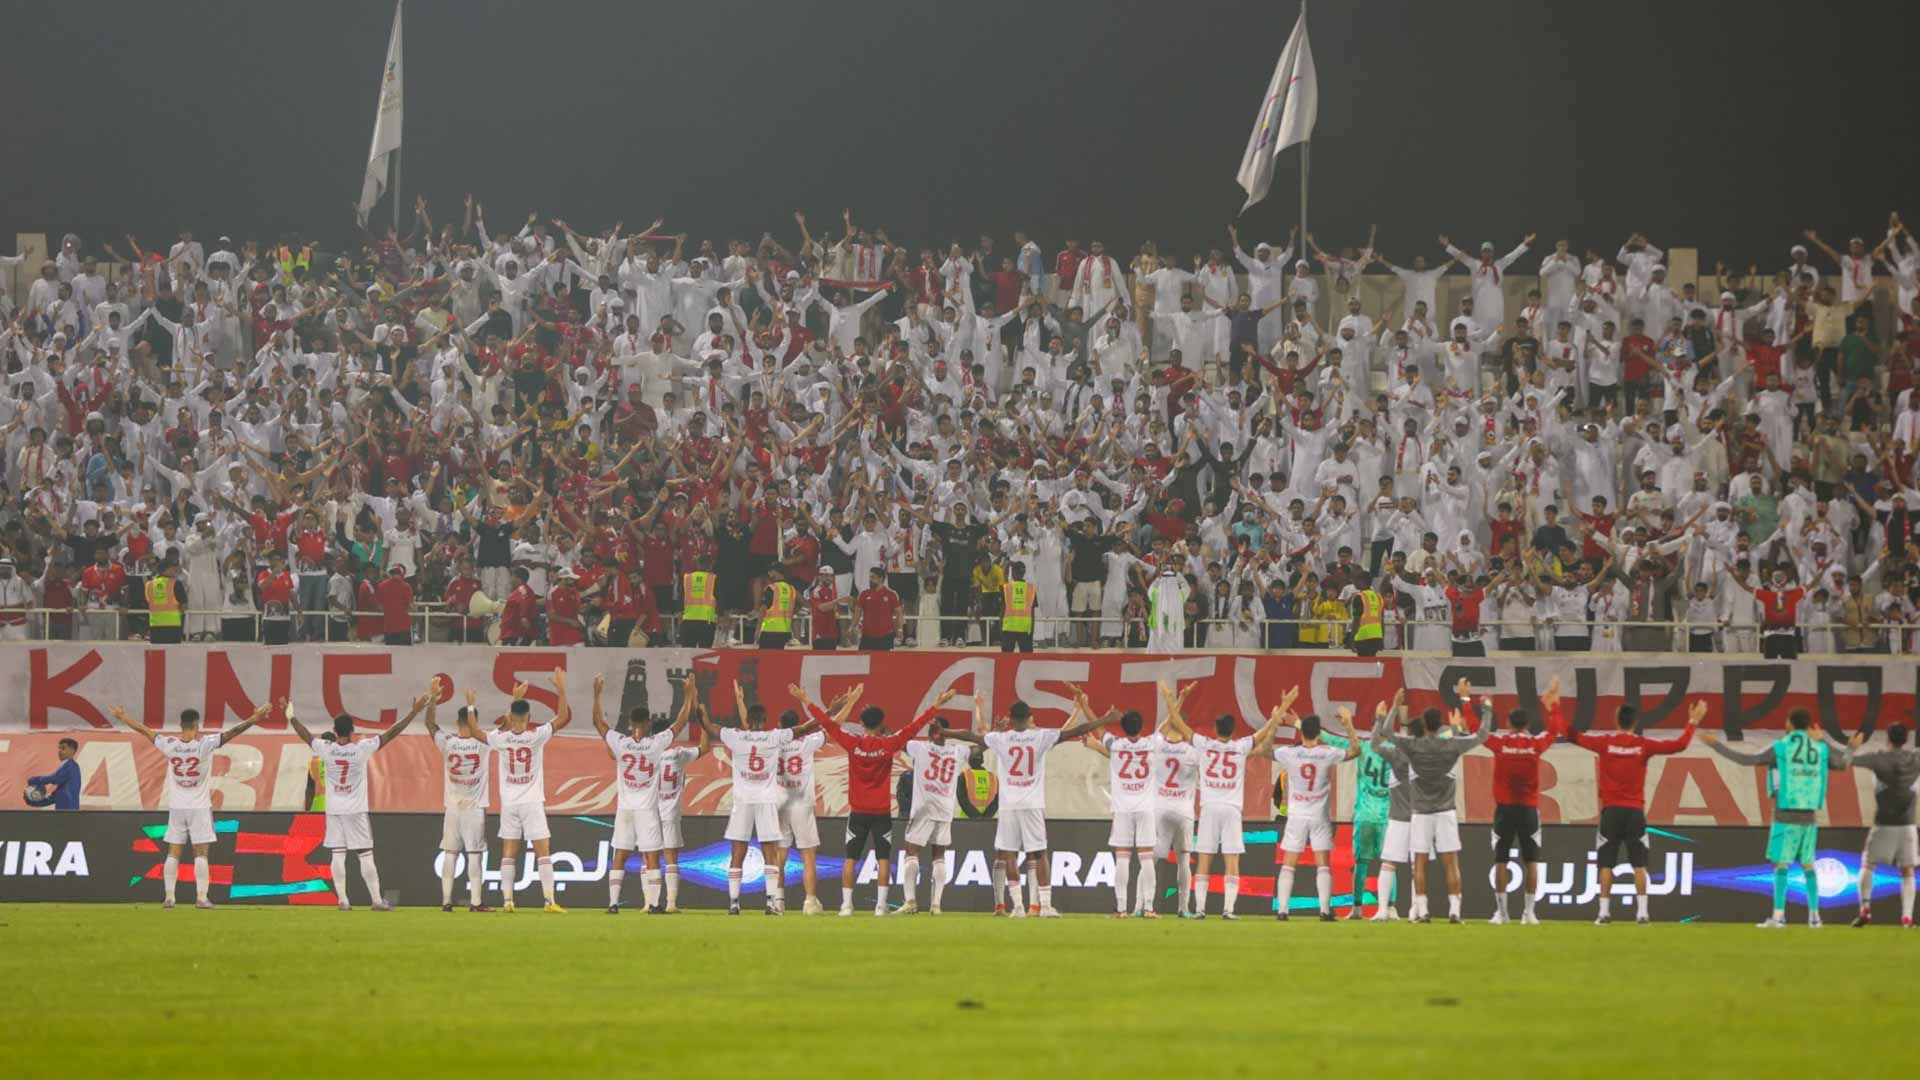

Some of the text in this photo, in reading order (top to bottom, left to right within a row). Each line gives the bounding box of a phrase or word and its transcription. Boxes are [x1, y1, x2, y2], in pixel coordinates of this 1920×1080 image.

[1438, 664, 1920, 745] SUPPO
[447, 753, 481, 776] 27
[506, 746, 533, 775] 19
[748, 744, 765, 773] 6
[1008, 745, 1035, 777] 21
[1118, 750, 1150, 780] 23
[1205, 749, 1238, 780] 25
[1790, 734, 1820, 766] 26
[170, 756, 201, 777] 22
[334, 759, 350, 785] 7
[621, 752, 655, 781] 24
[924, 750, 957, 784] 30
[1164, 757, 1180, 788] 2
[1300, 763, 1317, 792] 9
[0, 841, 90, 876] IRA
